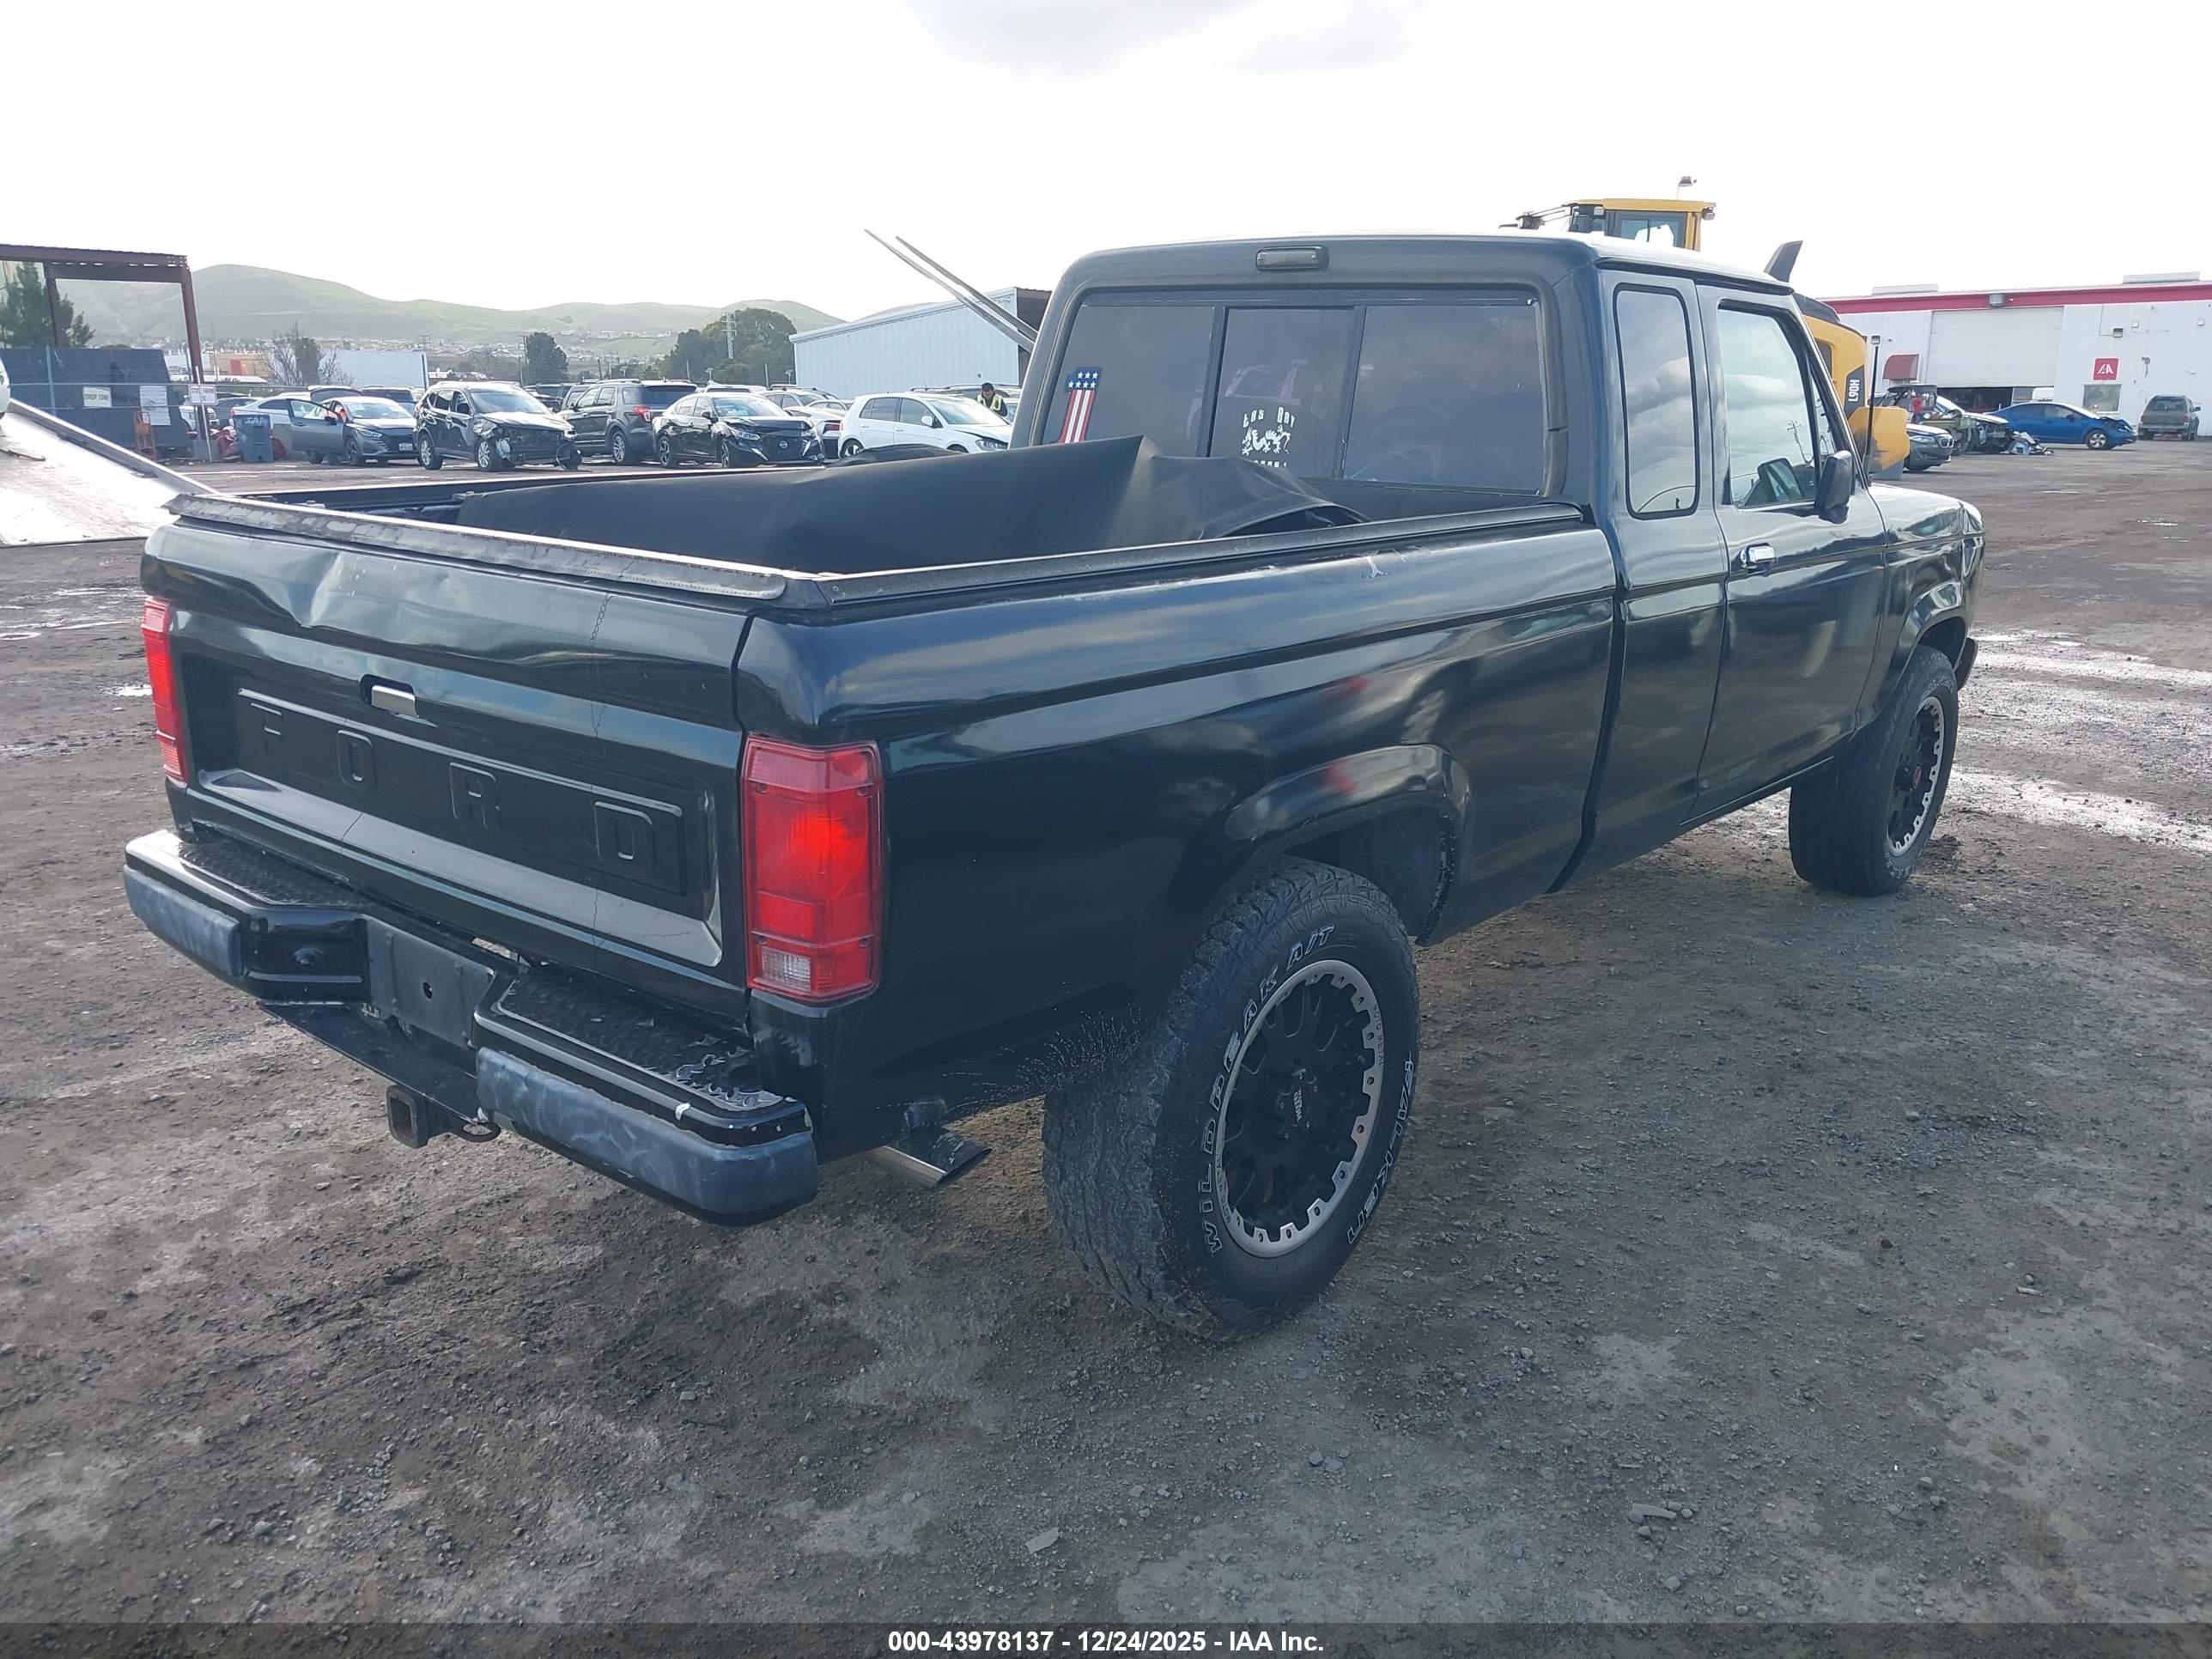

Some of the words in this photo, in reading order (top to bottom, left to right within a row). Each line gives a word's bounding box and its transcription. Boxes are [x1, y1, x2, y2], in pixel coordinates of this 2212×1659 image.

[1848, 379, 1860, 402] L90H
[250, 702, 654, 872] FORD
[1198, 964, 1279, 1254] WILDPEAK
[1286, 925, 1334, 971] A/T
[1346, 1051, 1414, 1244] FALKEN
